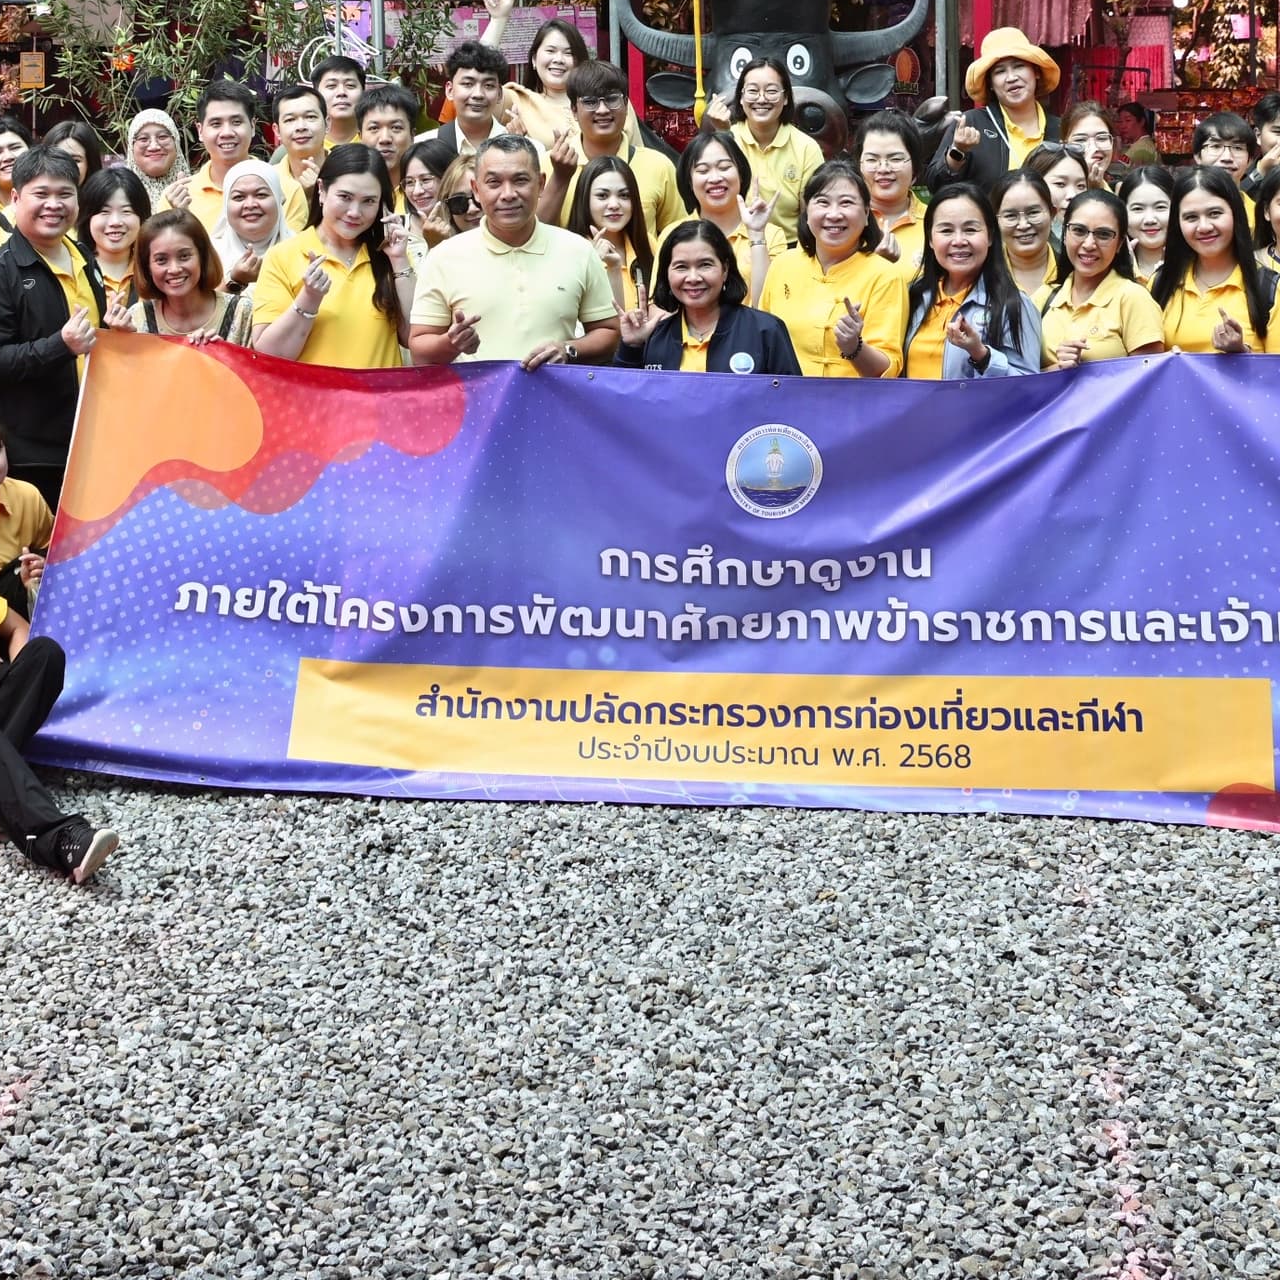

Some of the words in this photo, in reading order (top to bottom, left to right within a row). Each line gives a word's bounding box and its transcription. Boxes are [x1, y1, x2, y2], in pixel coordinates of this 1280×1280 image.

[599, 543, 932, 592] การศึกษาดูงาน
[415, 683, 1144, 733] สำนักงานปลัดกระทรวงการท่องเที่ยวและกีฬา
[578, 734, 819, 767] ประจำปีงบประมาณ
[832, 745, 886, 768] พ.ศ.
[898, 743, 972, 769] 2568
